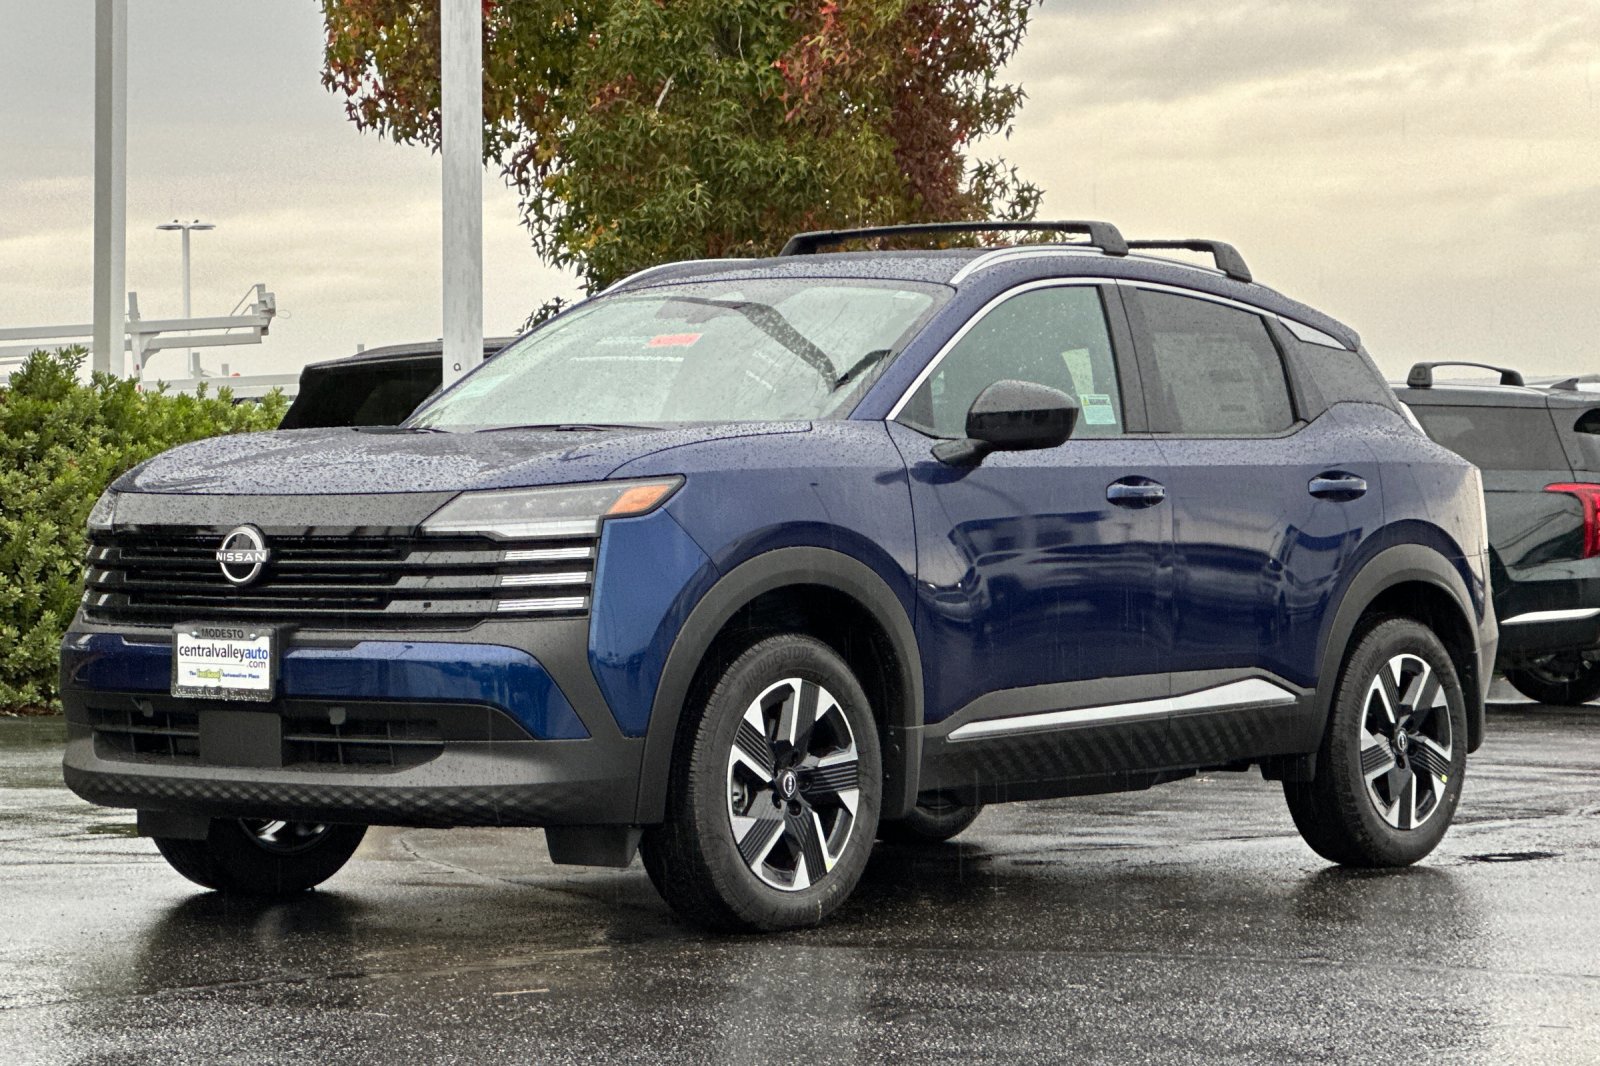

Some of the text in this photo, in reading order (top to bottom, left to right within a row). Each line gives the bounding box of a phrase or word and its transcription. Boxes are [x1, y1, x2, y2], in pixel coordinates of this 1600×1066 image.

[216, 552, 265, 562] NISSAN
[202, 629, 244, 638] MODESTO
[179, 643, 268, 662] centralvalleyauto
